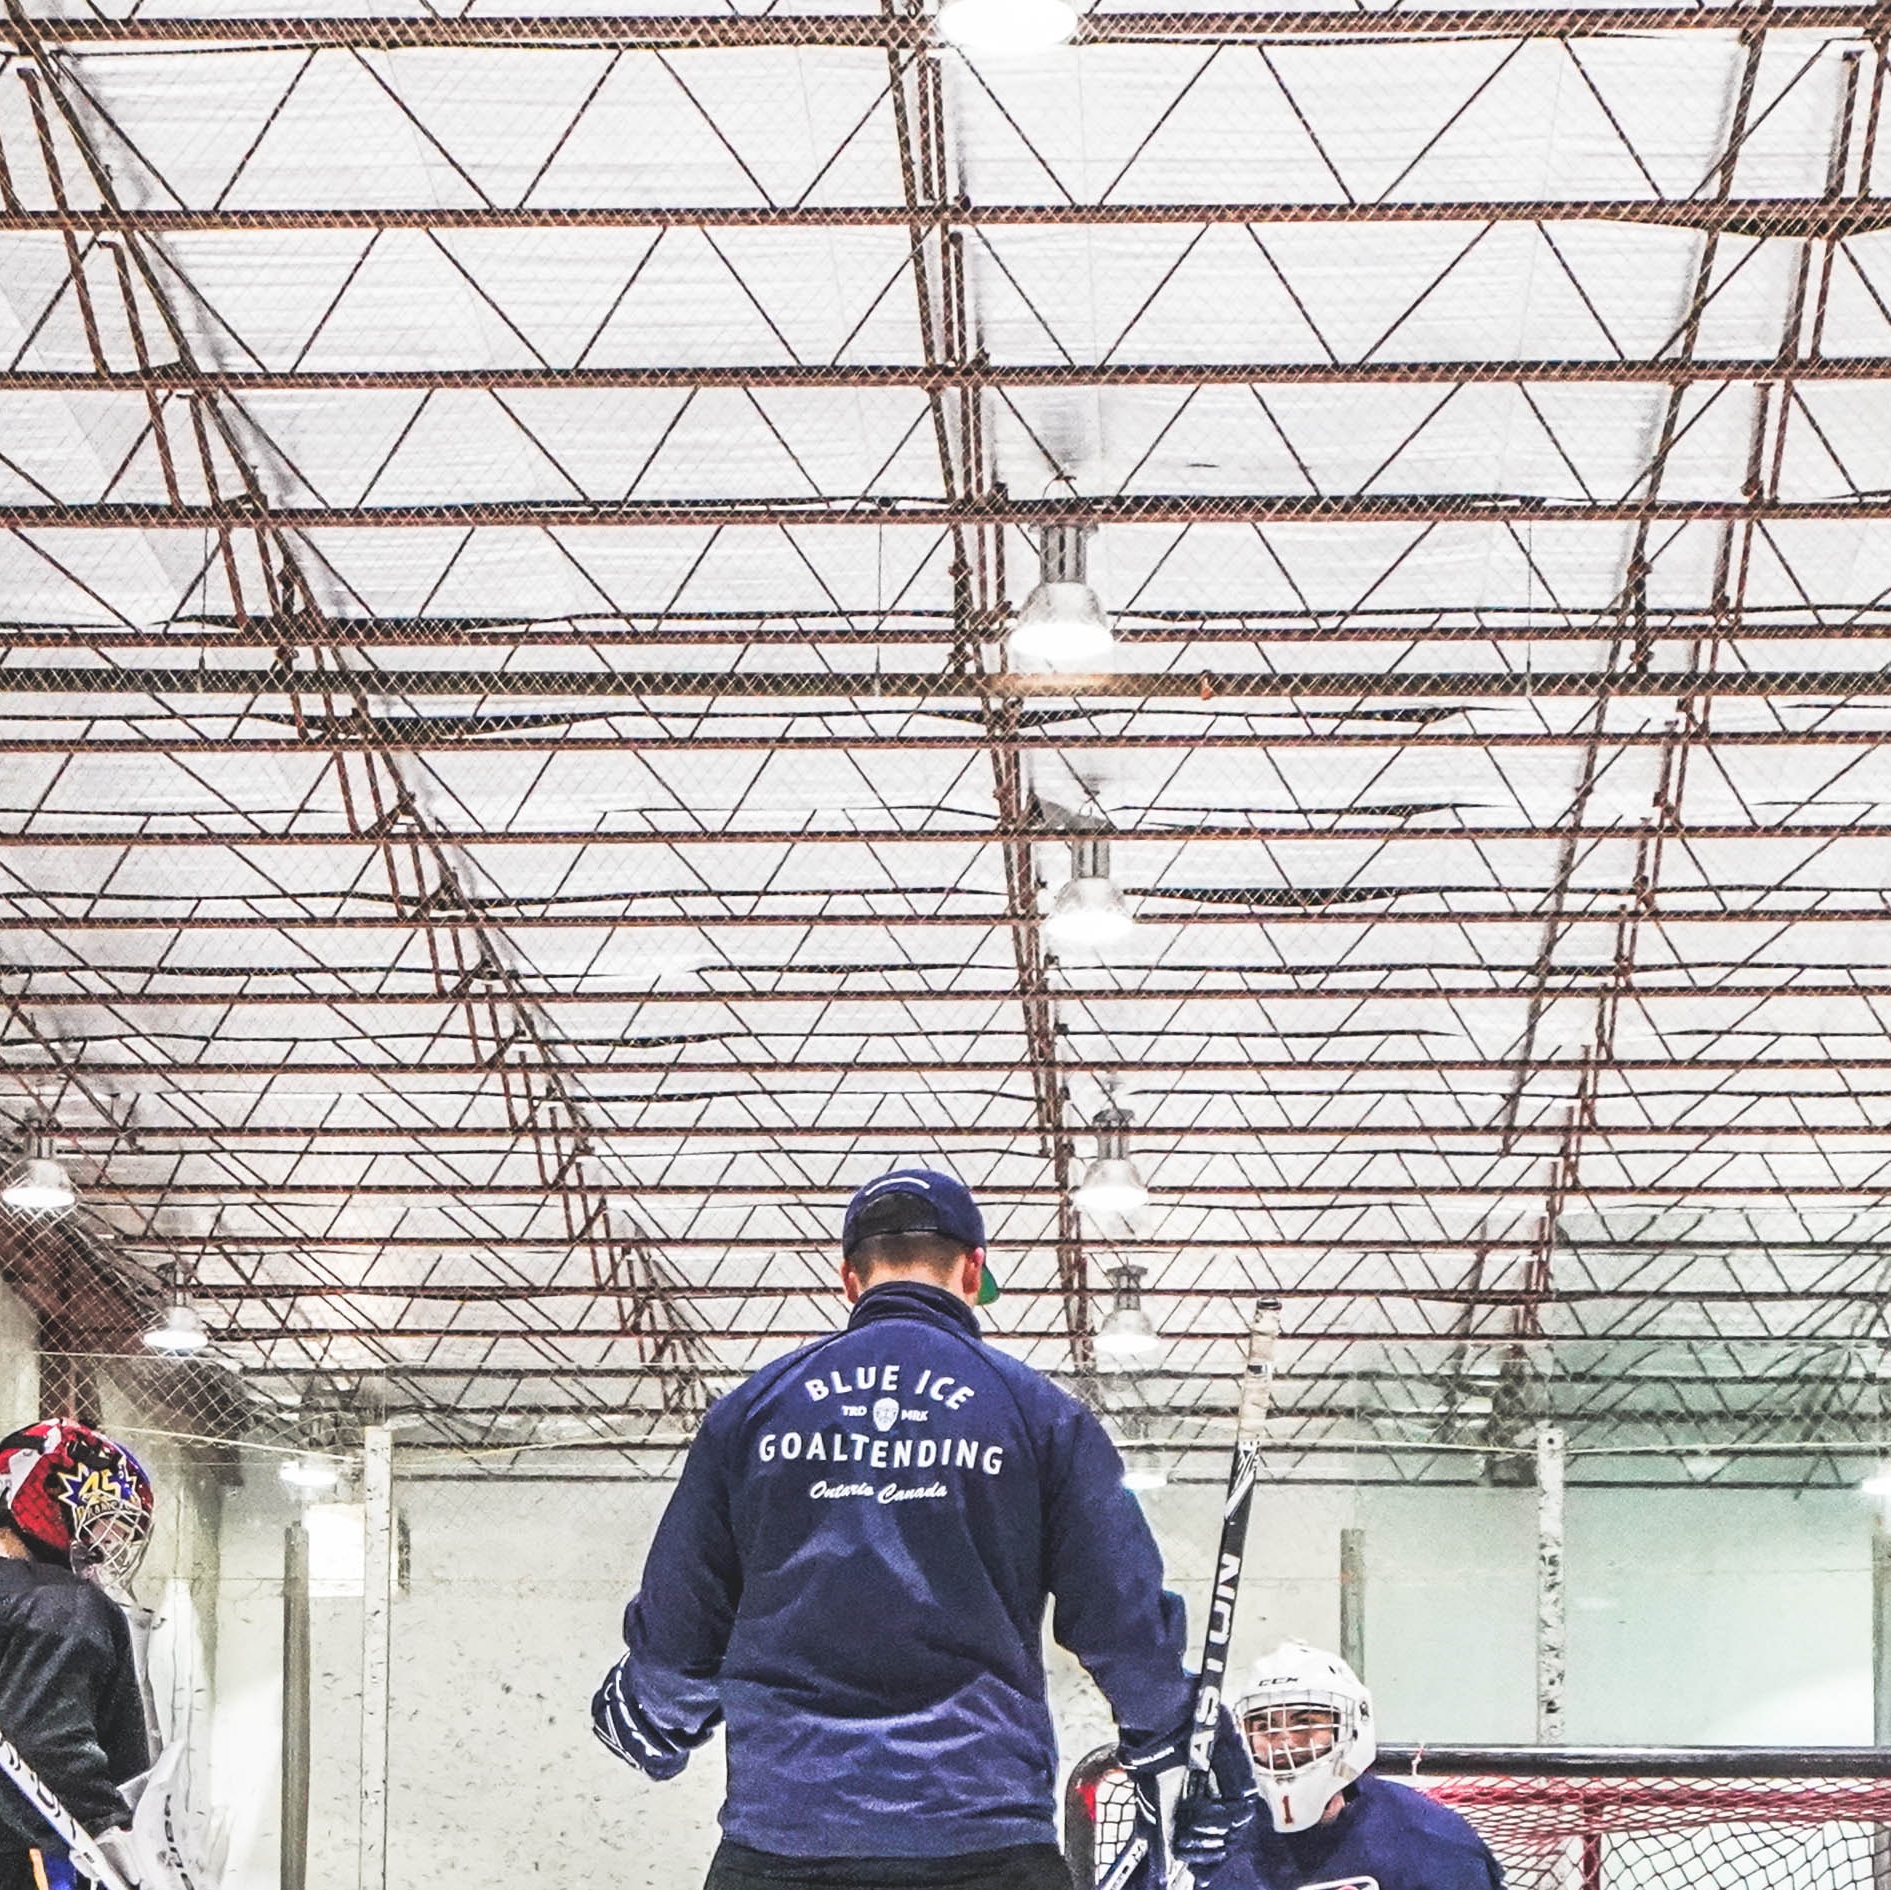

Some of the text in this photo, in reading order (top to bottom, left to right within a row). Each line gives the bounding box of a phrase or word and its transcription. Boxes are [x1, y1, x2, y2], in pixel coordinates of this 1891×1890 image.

[805, 1365, 975, 1410] BLUE ICE
[841, 1405, 867, 1417] TRD
[759, 1432, 1004, 1475] GOALTENDING
[810, 1480, 948, 1504] Ontario Canada
[1189, 1552, 1241, 1772] ASTON
[1282, 1795, 1294, 1824] 1
